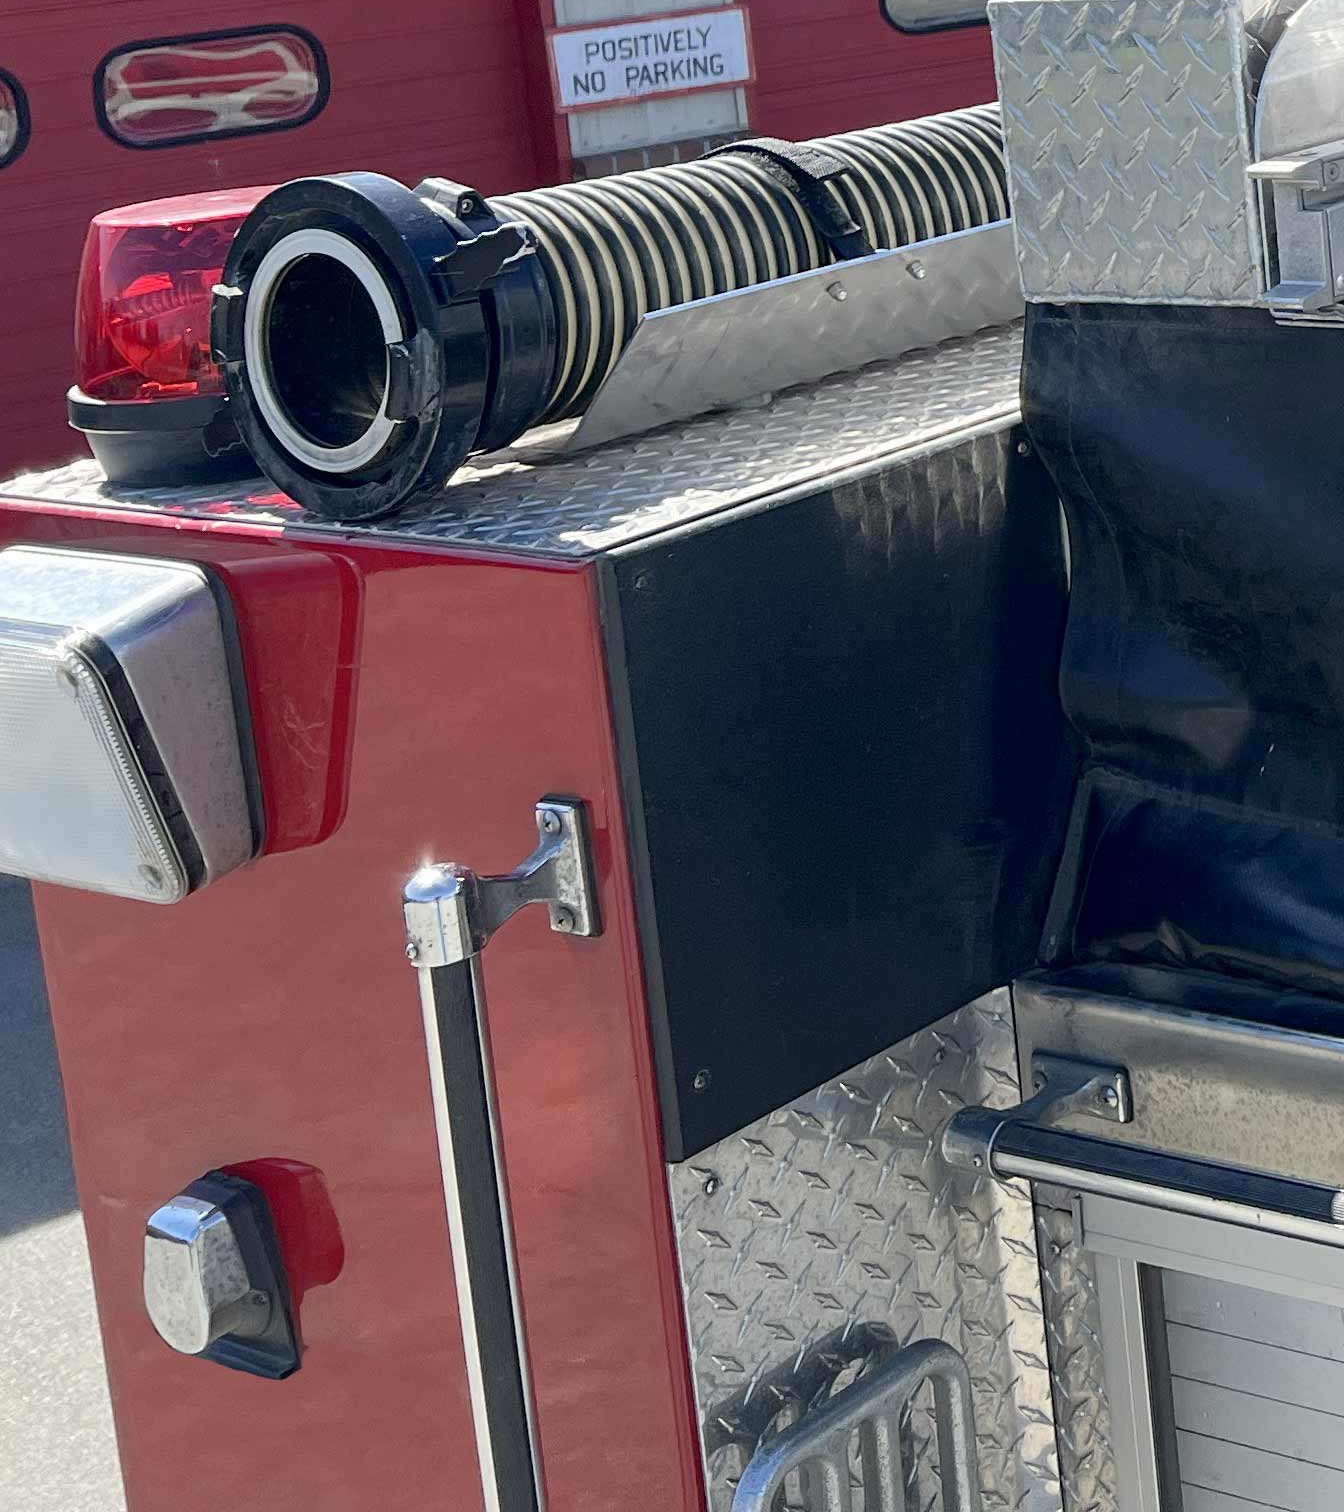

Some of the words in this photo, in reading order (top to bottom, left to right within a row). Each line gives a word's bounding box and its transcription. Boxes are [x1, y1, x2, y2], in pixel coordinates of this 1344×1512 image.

[584, 24, 712, 65] POSITIVELY
[572, 70, 606, 97] NO
[625, 53, 724, 89] PARKING
